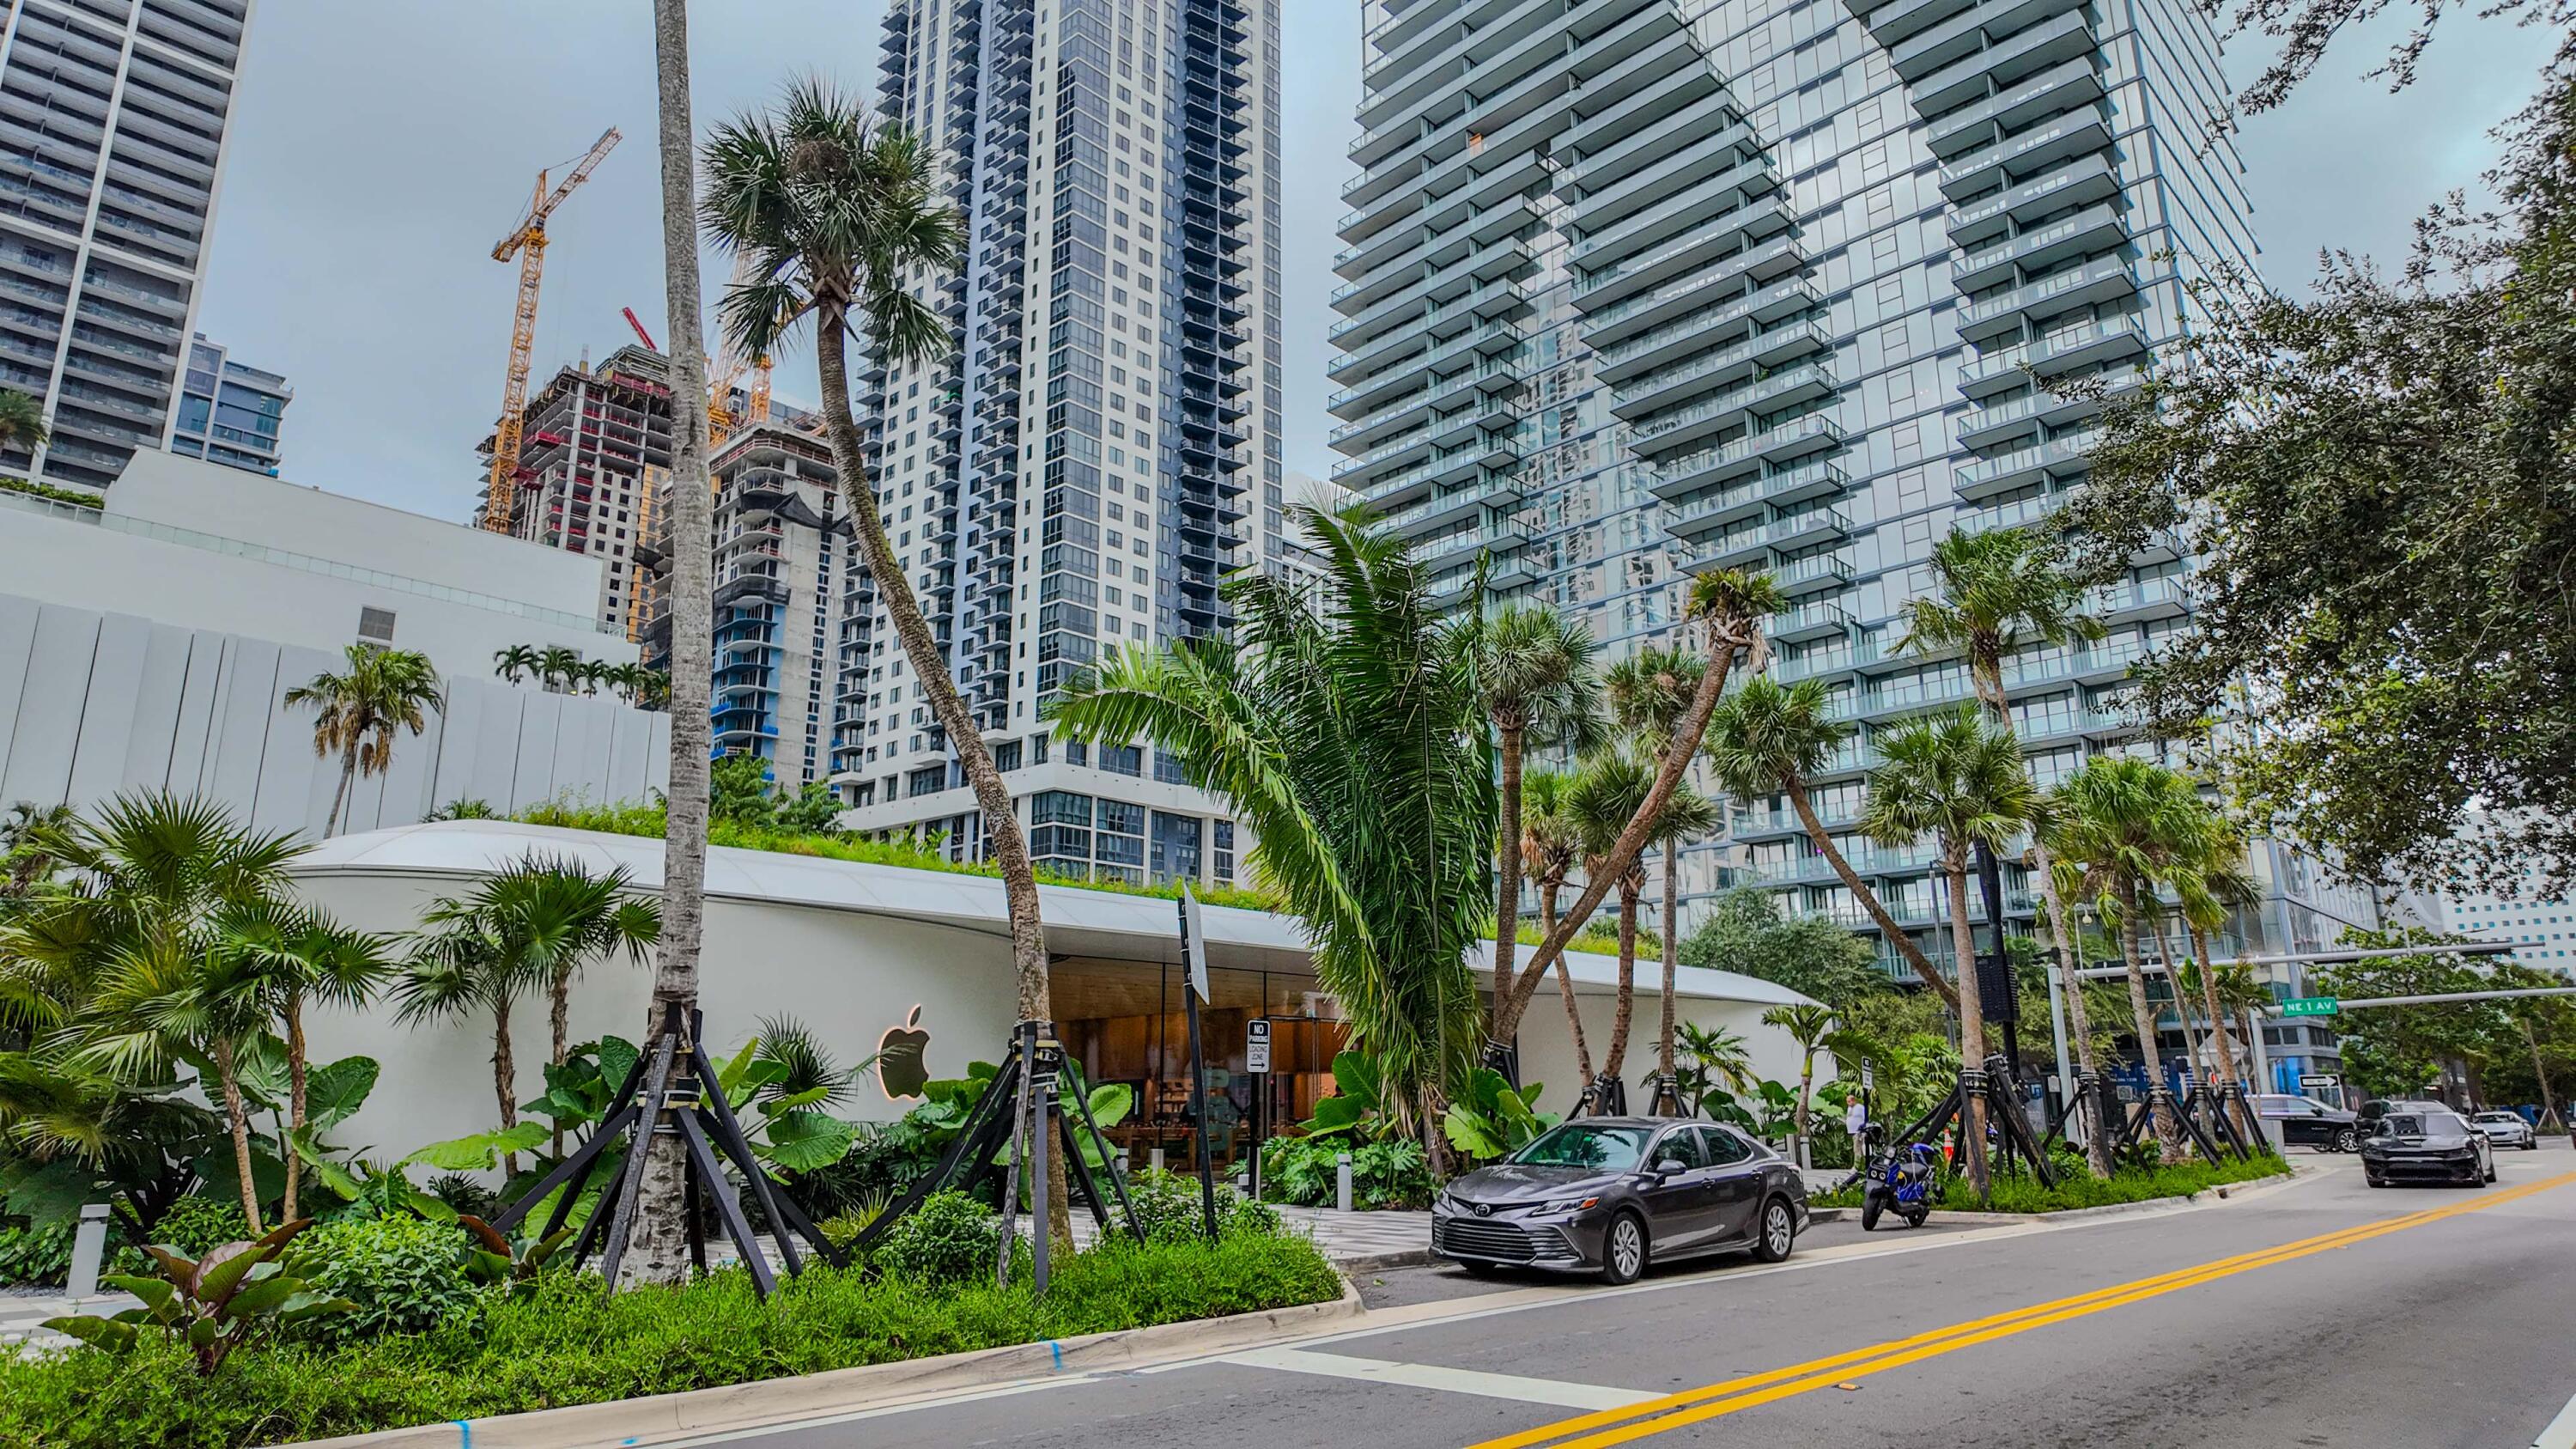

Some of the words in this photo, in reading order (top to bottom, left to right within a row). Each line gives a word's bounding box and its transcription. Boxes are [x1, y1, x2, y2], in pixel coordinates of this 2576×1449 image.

[2287, 1003, 2302, 1012] NE
[2306, 1002, 2312, 1012] 1
[2316, 1002, 2331, 1010] AV
[1254, 1024, 1264, 1035] NO
